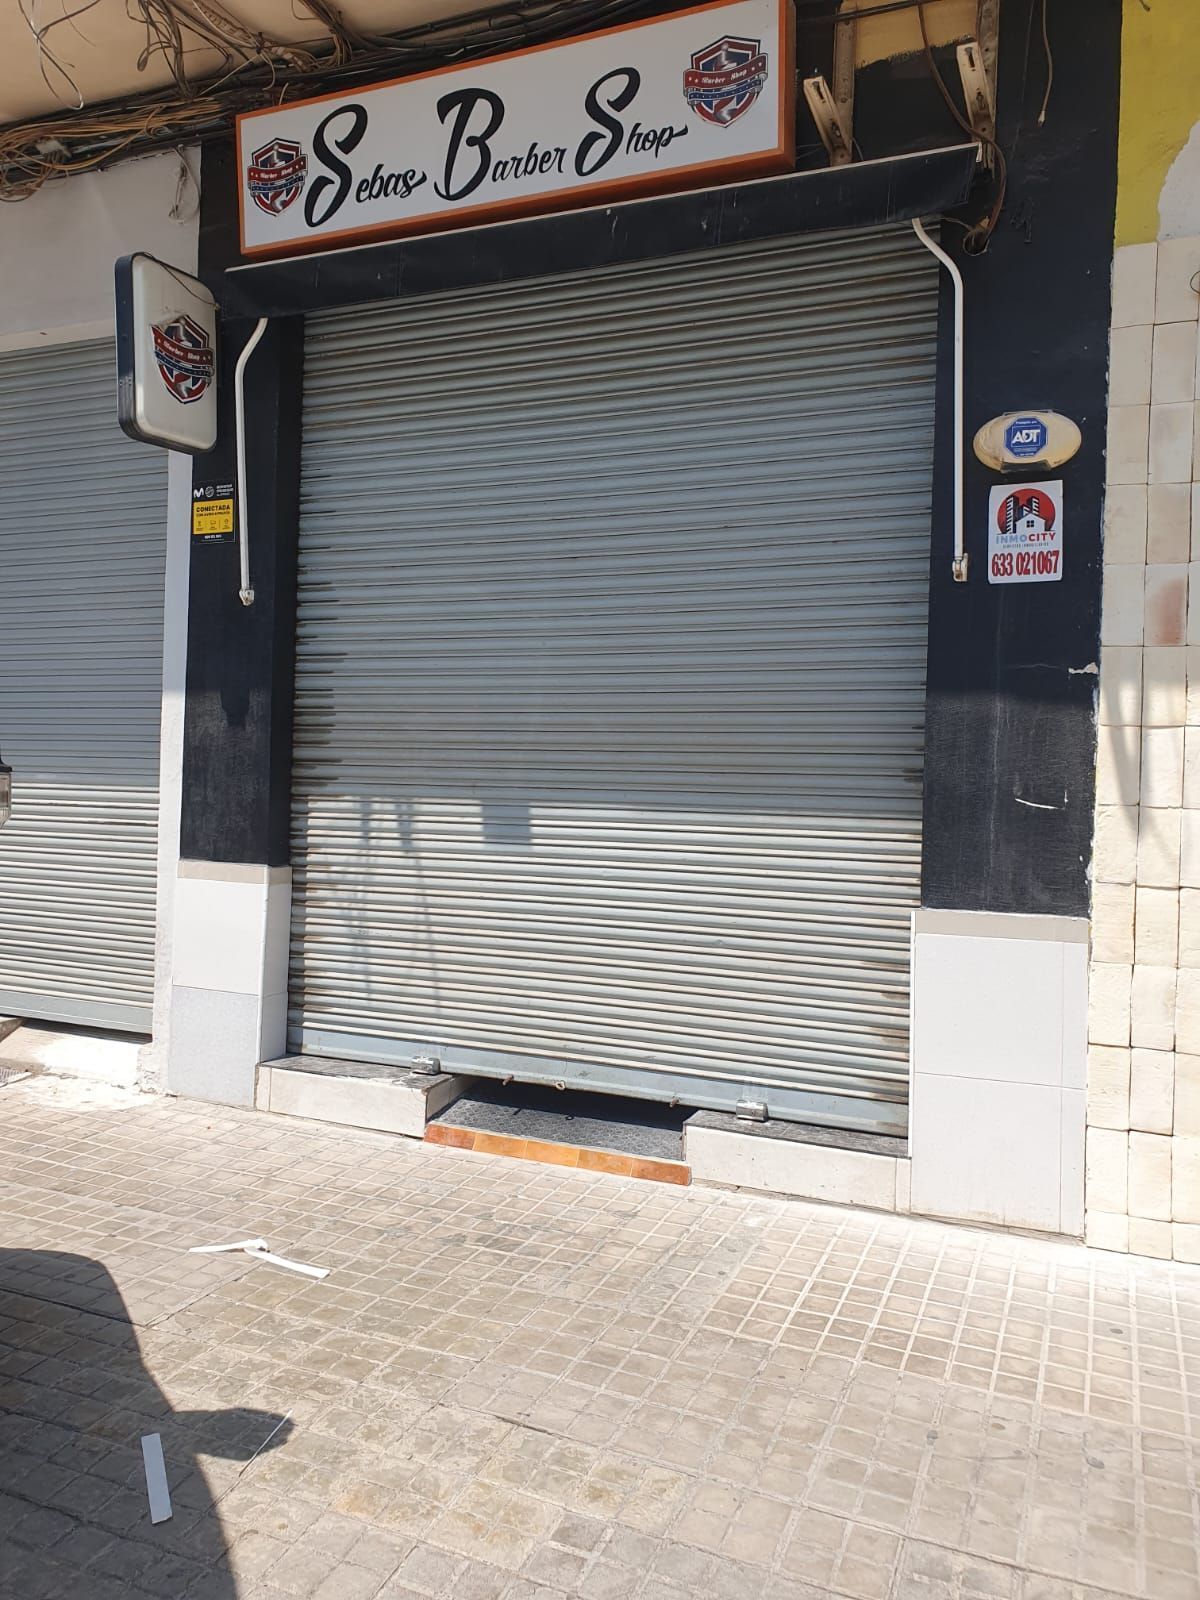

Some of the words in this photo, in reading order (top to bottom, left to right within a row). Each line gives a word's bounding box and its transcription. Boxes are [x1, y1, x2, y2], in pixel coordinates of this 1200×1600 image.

[305, 103, 426, 228] Sebas
[433, 87, 567, 201] Barber
[575, 67, 688, 177] Shop
[1012, 429, 1041, 444] ADT
[996, 532, 1056, 545] INMOCITY
[992, 552, 1014, 577] 633
[1016, 550, 1060, 576] 021067
